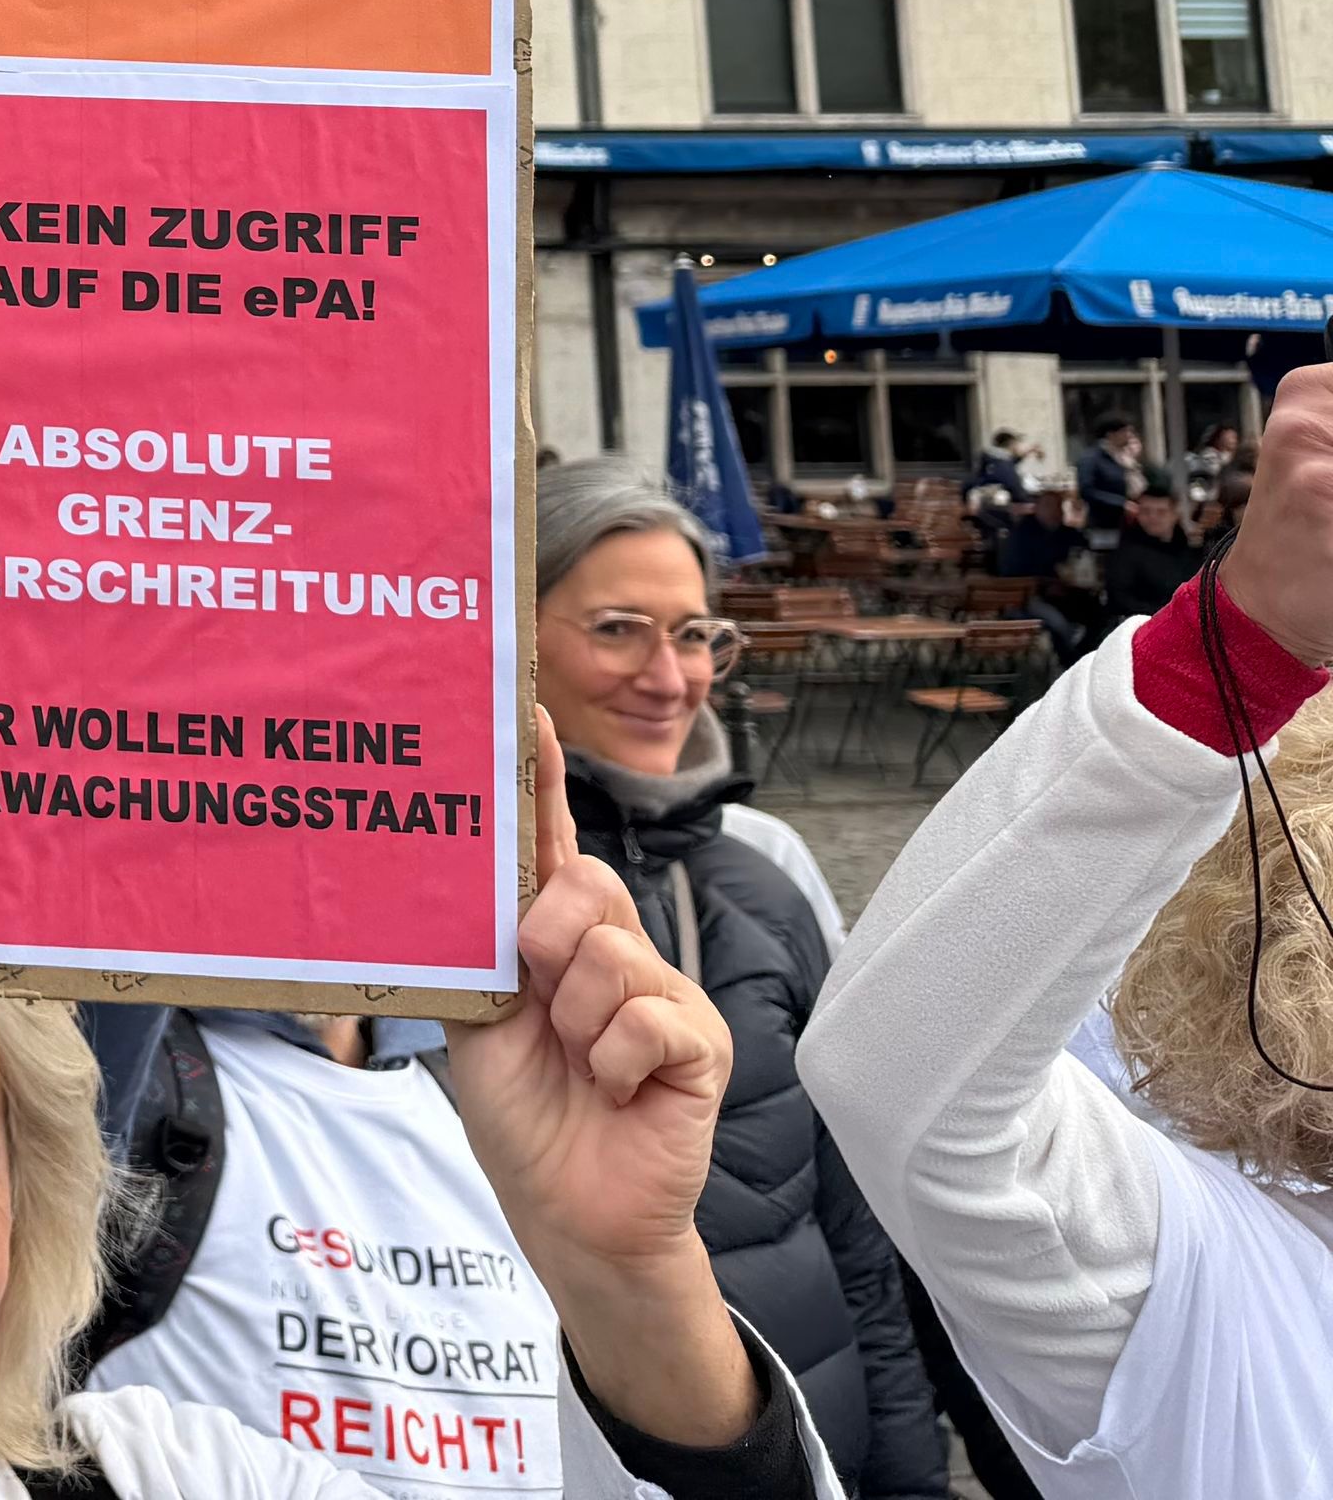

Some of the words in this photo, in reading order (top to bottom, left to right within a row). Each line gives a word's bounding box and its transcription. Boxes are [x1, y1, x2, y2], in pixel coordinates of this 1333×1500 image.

[148, 207, 419, 257] ZUGRIFF
[122, 271, 221, 315] DIE
[244, 277, 375, 321] ePA!
[57, 493, 292, 544] GRENZ-
[32, 705, 243, 758] WOLLEN
[264, 718, 422, 767] KEINE
[280, 1389, 526, 1474] REICHT!
